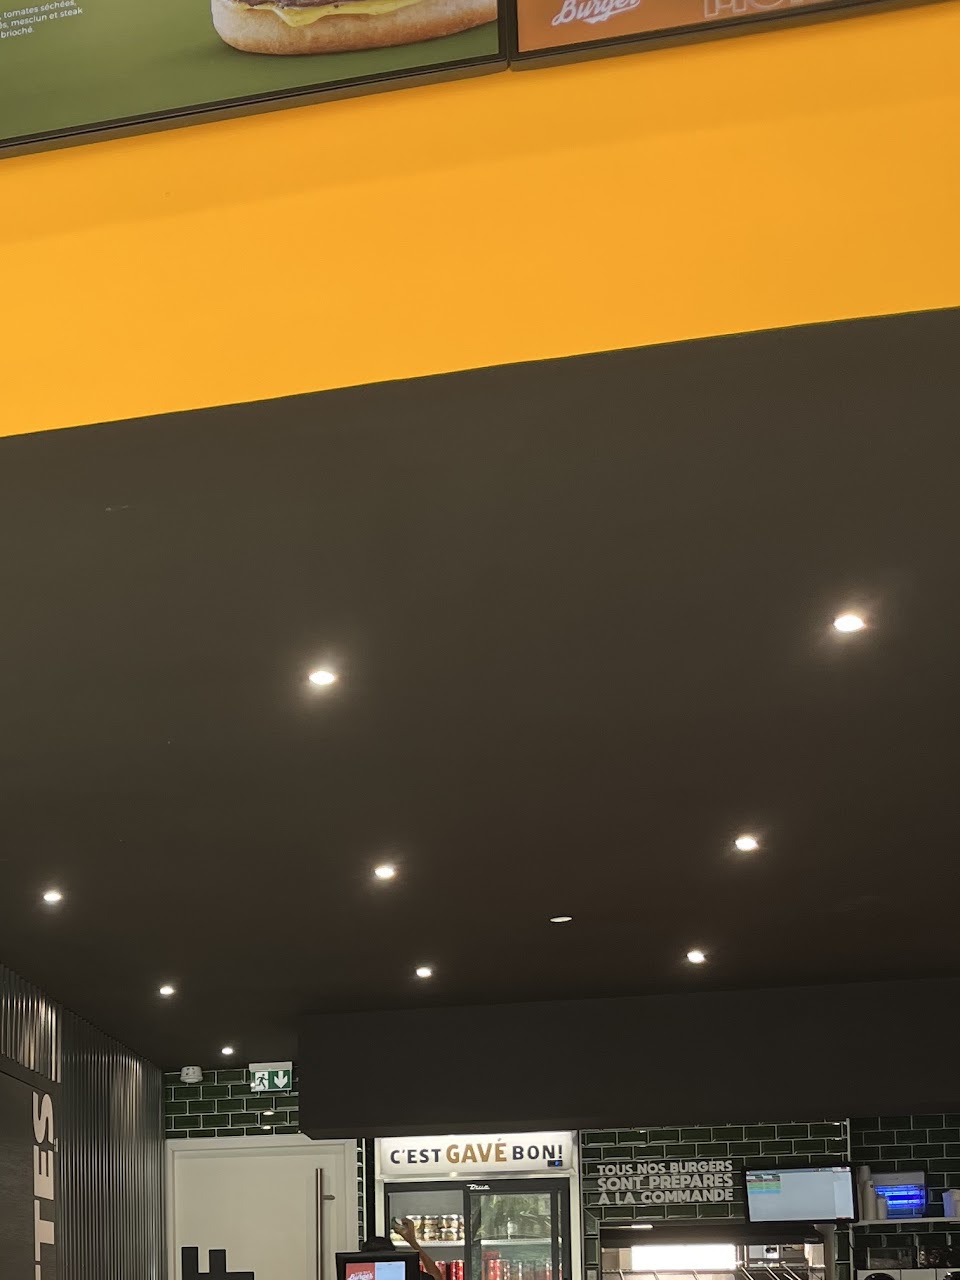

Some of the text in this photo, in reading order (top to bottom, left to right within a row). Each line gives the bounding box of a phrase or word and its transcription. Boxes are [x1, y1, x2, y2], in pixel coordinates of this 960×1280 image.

[4, 7, 38, 18] tomates
[11, 15, 47, 27] mesclun
[60, 7, 83, 18] steak
[1, 26, 35, 39] brioché.
[390, 1138, 563, 1164] C'EST GAVÉ BON!
[597, 1160, 733, 1175] TOUS NOS BURGERS
[597, 1176, 644, 1191] SONT
[615, 1191, 636, 1205] LA
[640, 1189, 734, 1203] COMMANDE
